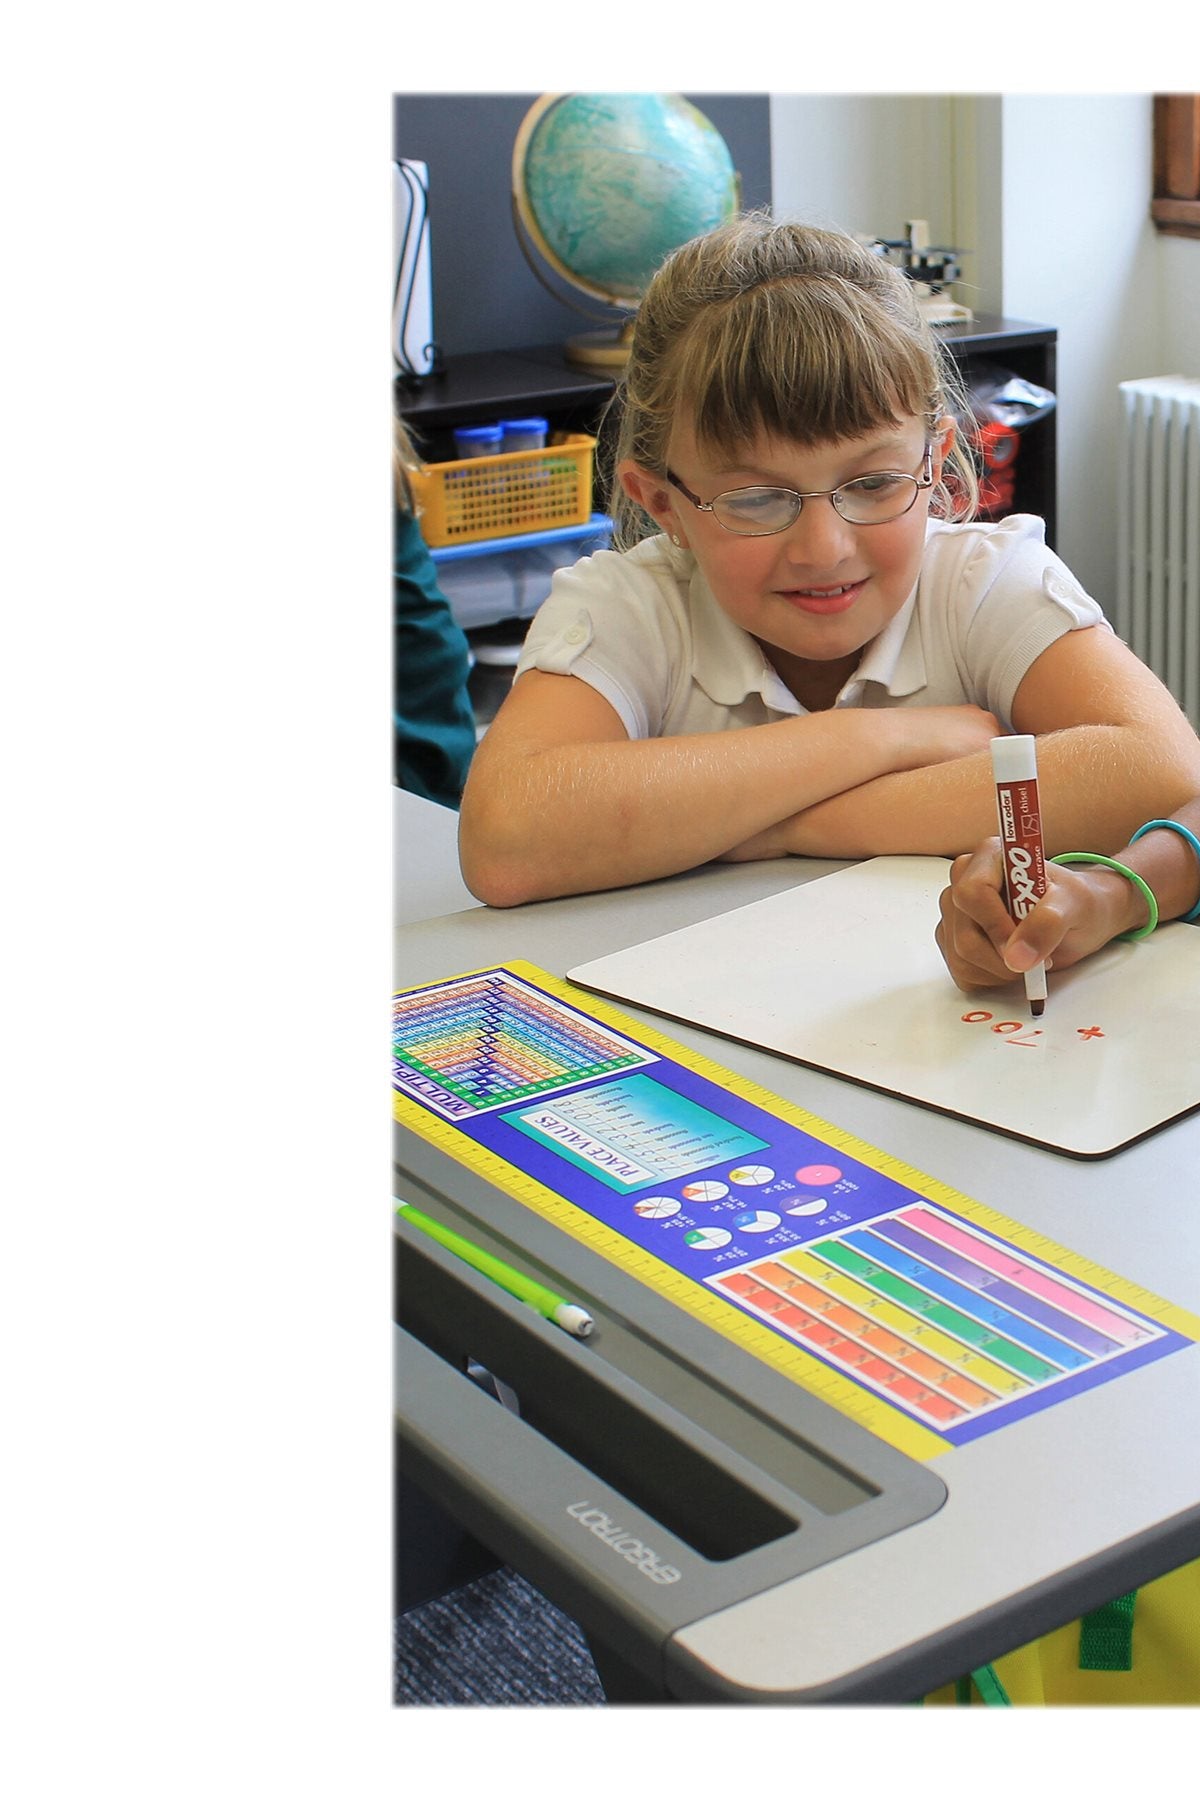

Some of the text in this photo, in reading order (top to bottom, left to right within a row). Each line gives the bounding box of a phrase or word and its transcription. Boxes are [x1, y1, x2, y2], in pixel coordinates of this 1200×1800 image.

[1002, 794, 1015, 839] low odor
[1018, 787, 1029, 813] chisel
[1008, 847, 1040, 921] EXPO
[1034, 845, 1045, 894] dry erase
[393, 1062, 467, 1111] MULTIPL
[534, 1114, 641, 1177] PLACE VALUES
[566, 1500, 682, 1585] ERGOTRON
